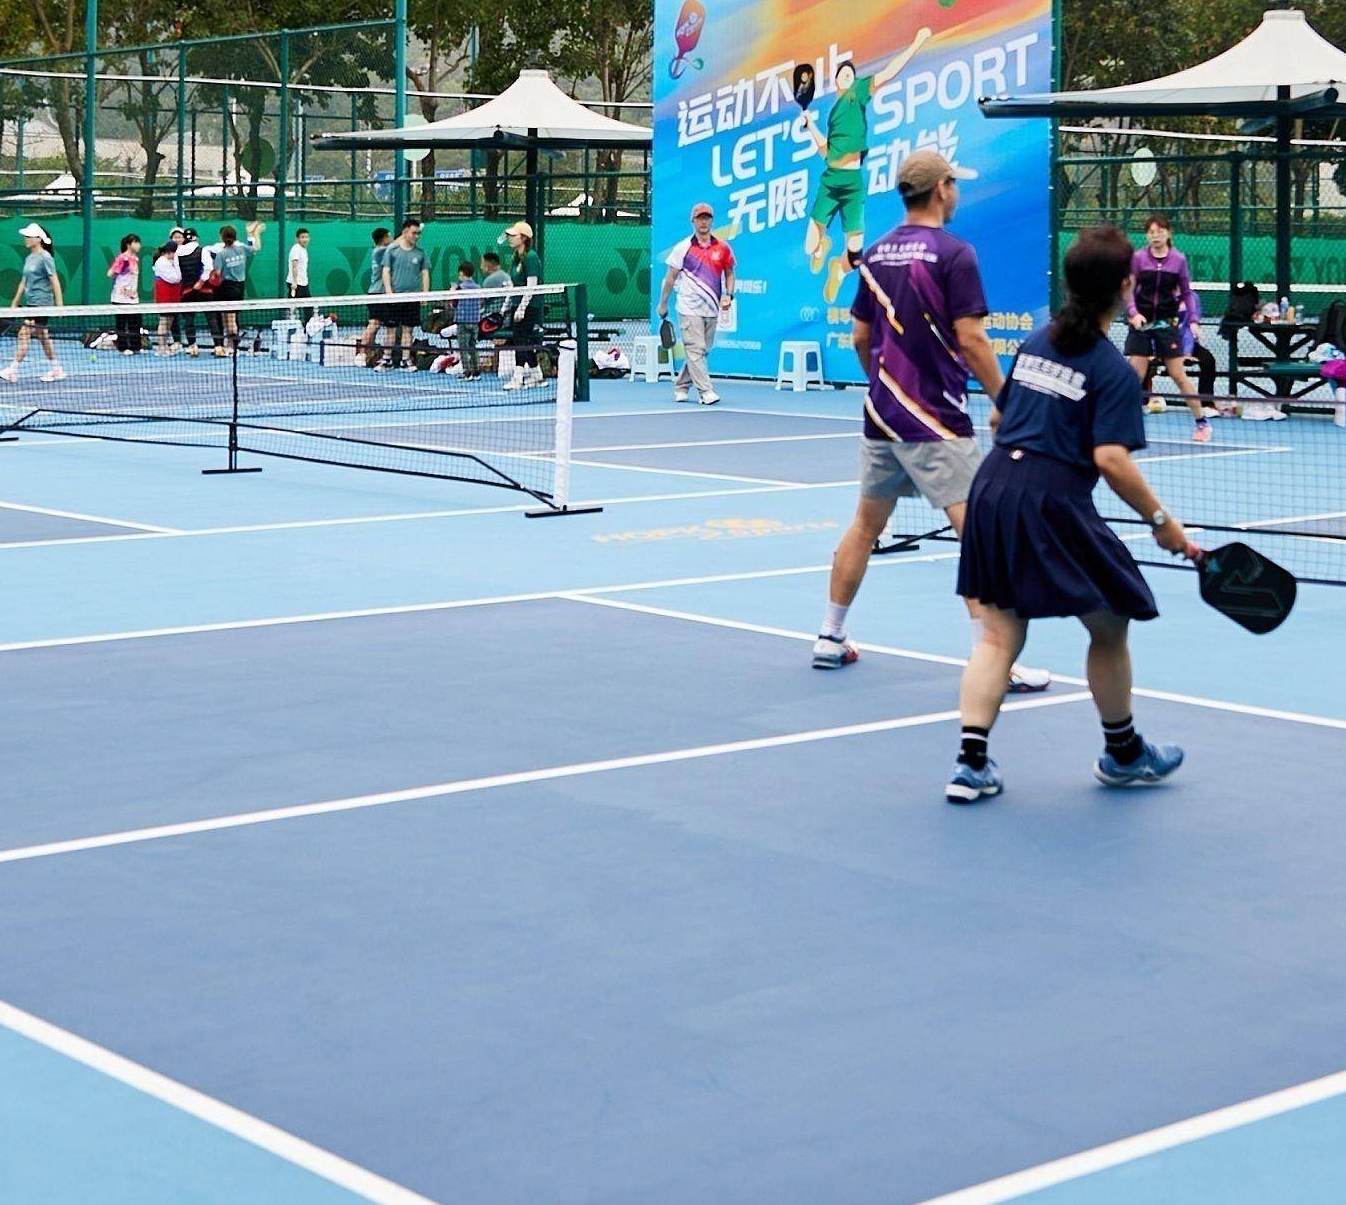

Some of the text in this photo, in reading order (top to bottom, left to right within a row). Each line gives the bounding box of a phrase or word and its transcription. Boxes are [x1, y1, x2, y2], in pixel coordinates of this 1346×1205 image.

[711, 32, 1039, 188] LET'S SPORT
[727, 168, 809, 241] 无限
